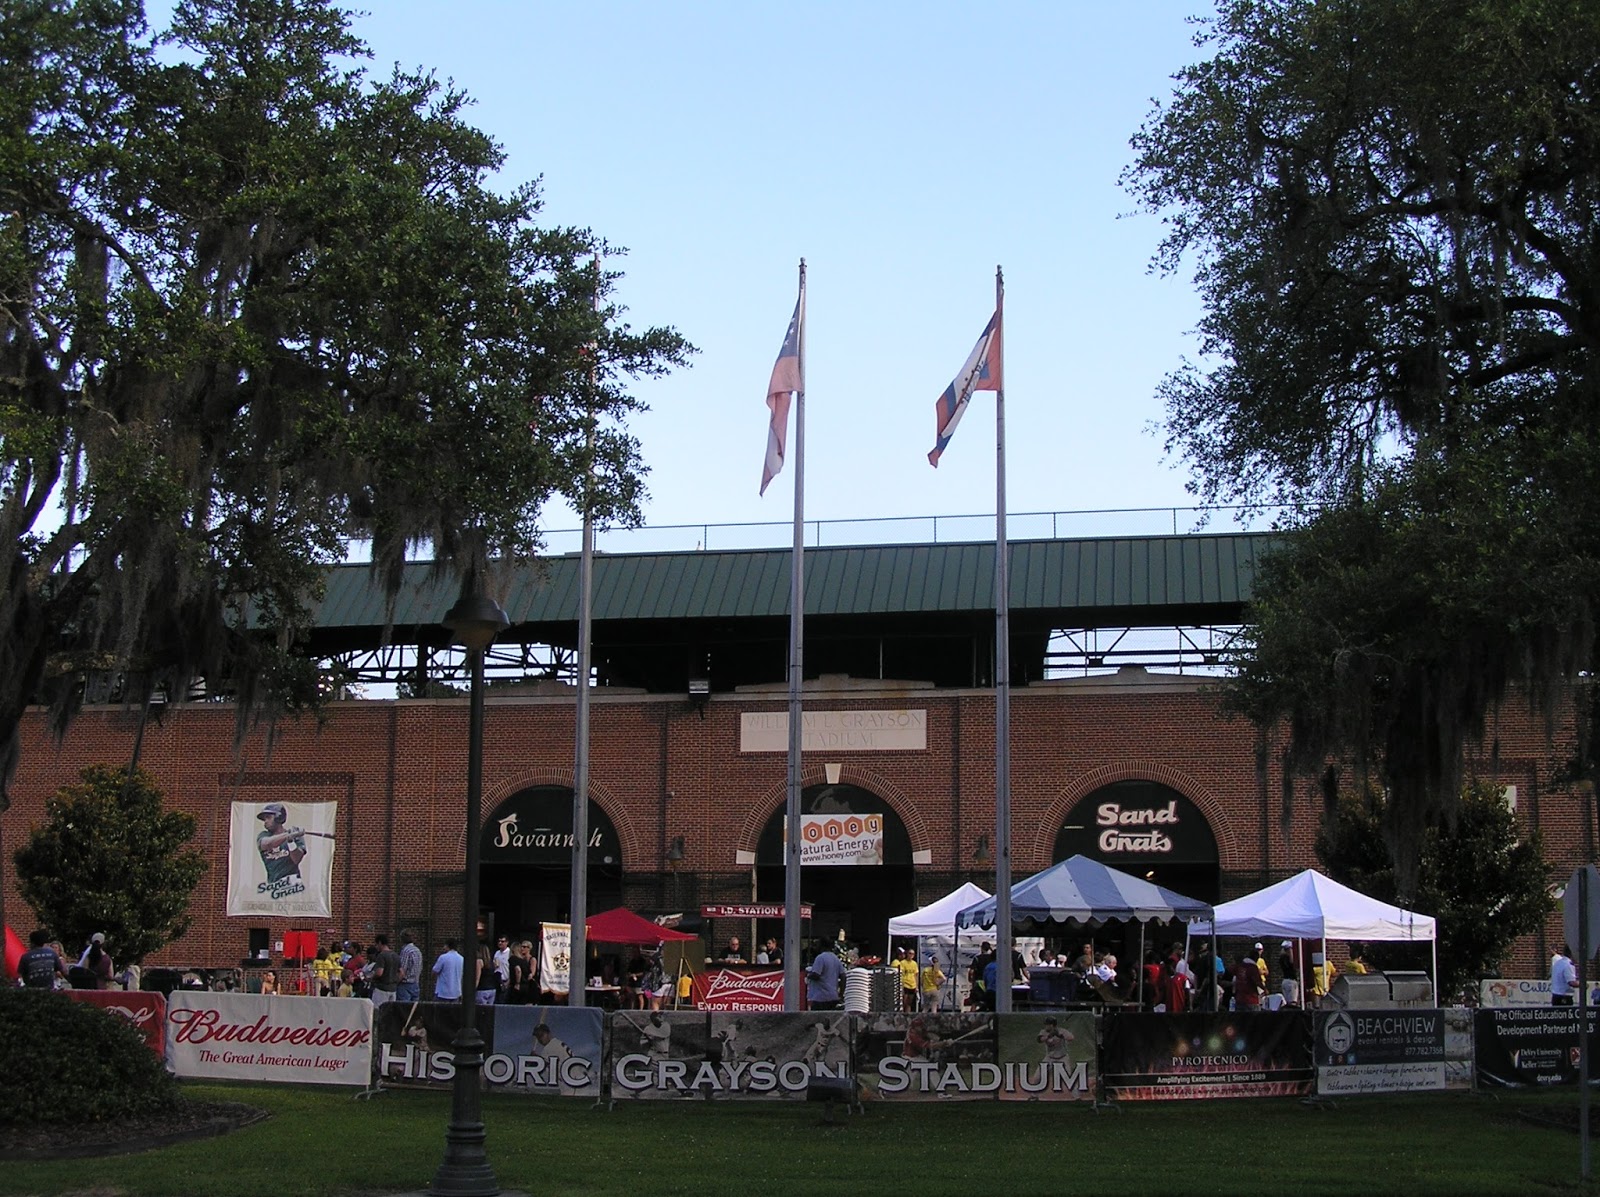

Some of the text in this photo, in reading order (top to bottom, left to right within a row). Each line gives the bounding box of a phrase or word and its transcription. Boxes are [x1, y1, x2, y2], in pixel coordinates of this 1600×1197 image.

[748, 713, 816, 729] WILLIM
[841, 711, 922, 728] GRAYSON
[805, 732, 875, 747] TADIUM
[1097, 800, 1179, 825] Sand
[494, 813, 603, 848] Savannh
[808, 817, 878, 838] oney
[800, 838, 875, 856] atural Energy
[1098, 829, 1173, 852] Gnats
[801, 850, 862, 863] www.honey.com
[257, 876, 291, 893] Sand
[271, 882, 305, 899] Gnats
[738, 906, 779, 915] STATION
[1519, 981, 1552, 993] Culli
[697, 1001, 785, 1012] ENJOY RESPONSI
[1494, 1008, 1597, 1020] The Official Education & Ceer
[169, 1008, 370, 1047] Budweiser
[1357, 1016, 1436, 1035] BEACHVIEW
[1497, 1024, 1542, 1037] Development
[1543, 1024, 1567, 1034] Partner
[1568, 1023, 1576, 1033] of
[1357, 1036, 1377, 1045] event
[1379, 1036, 1404, 1045] rentals
[1413, 1035, 1436, 1045] design
[199, 1049, 349, 1071] The Great American Lager
[381, 1042, 592, 1087] HISORIC
[1172, 1054, 1248, 1067] PYROTECNICO
[615, 1053, 847, 1091] GRAYSON
[877, 1056, 1088, 1092] STADIUM
[1157, 1076, 1191, 1085] Amplifying
[1191, 1075, 1226, 1083] Excitement
[1232, 1074, 1250, 1082] Since
